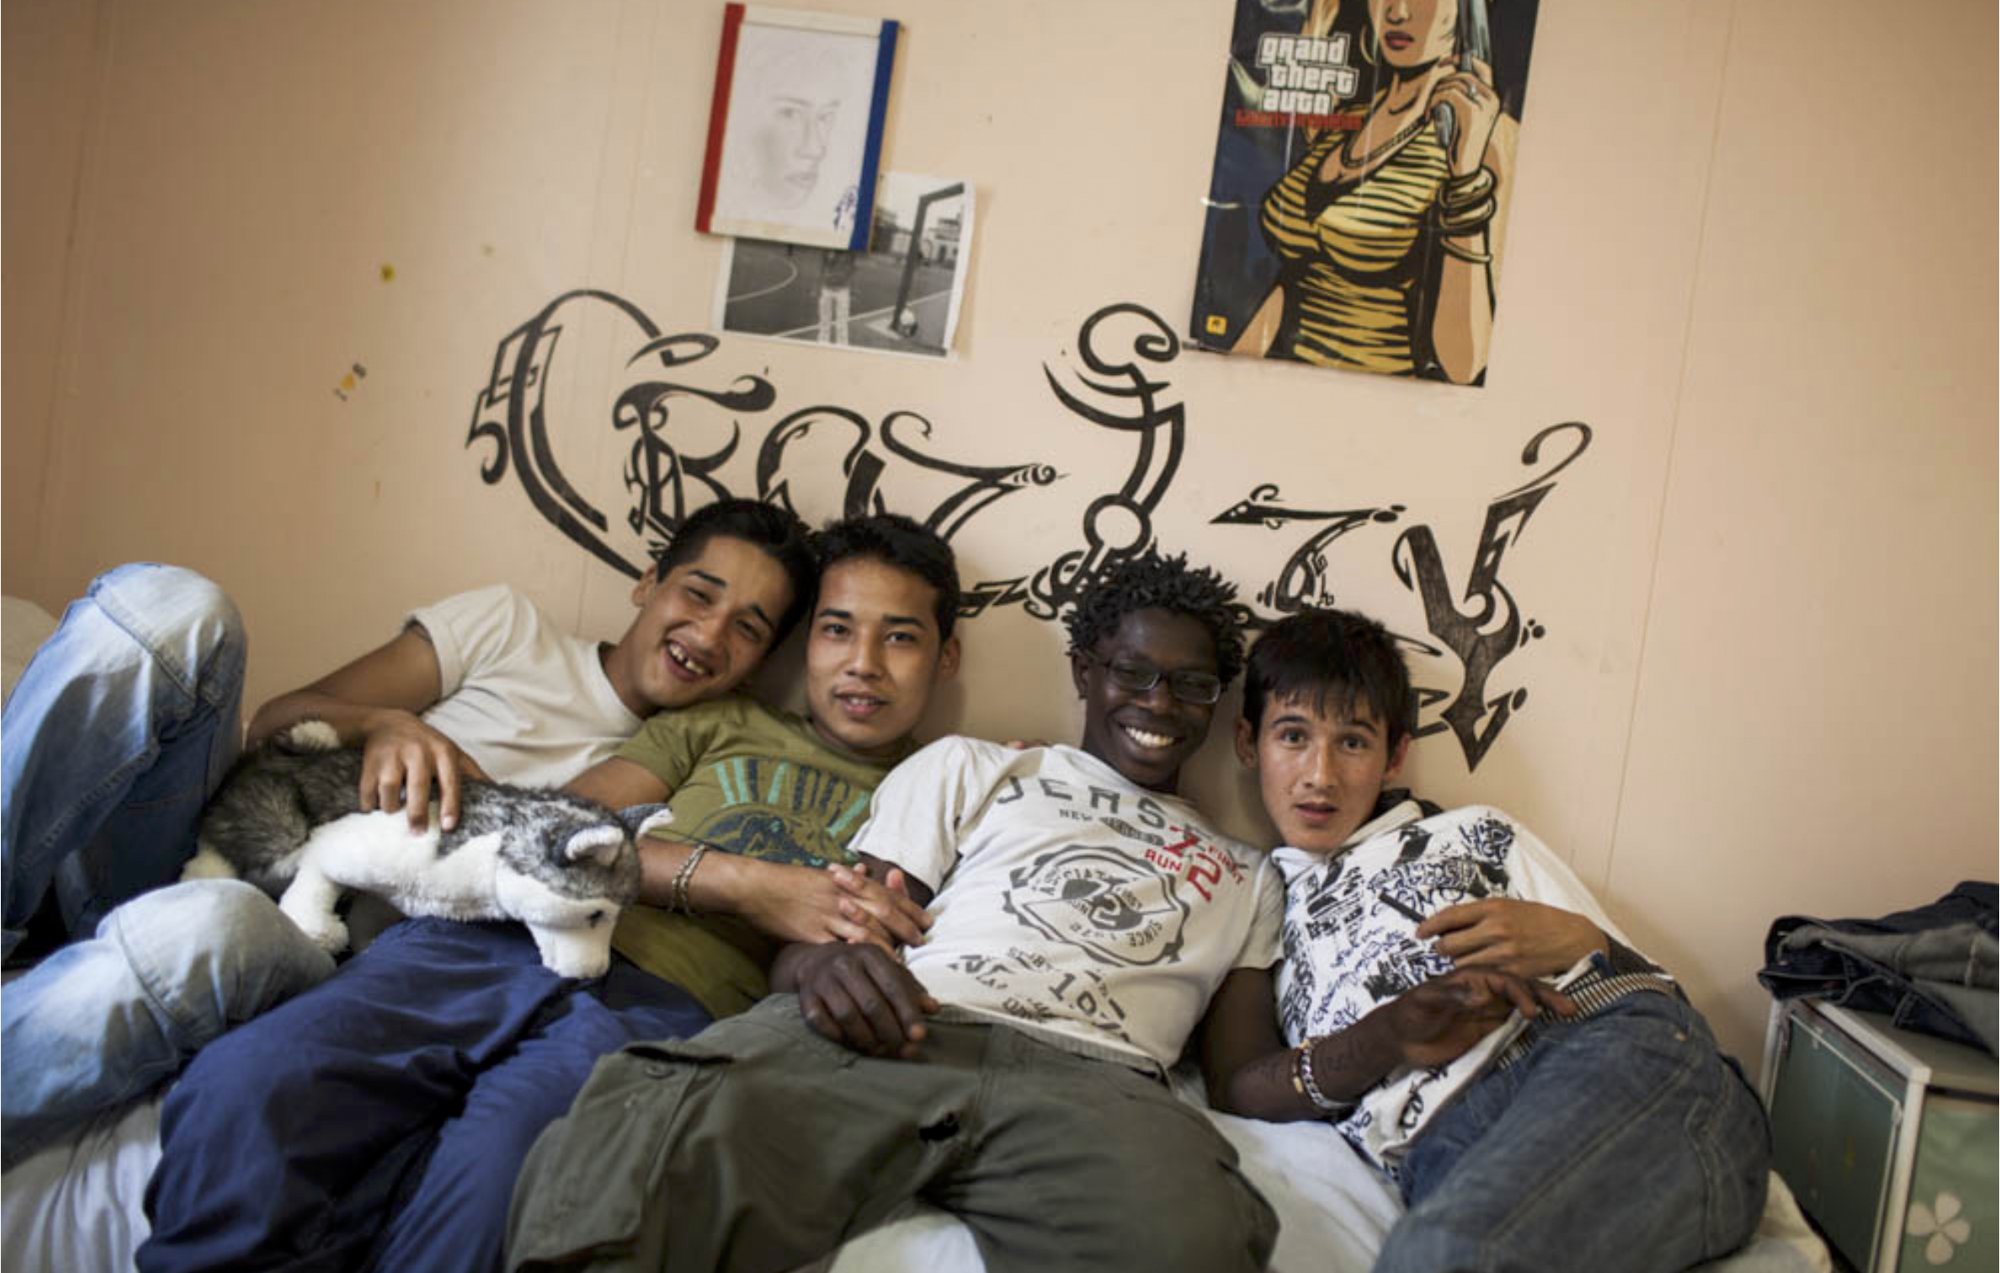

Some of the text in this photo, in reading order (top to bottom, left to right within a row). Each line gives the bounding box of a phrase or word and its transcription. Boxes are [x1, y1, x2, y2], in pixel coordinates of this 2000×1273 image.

[1261, 36, 1346, 65] grand
[1271, 61, 1354, 94] theft
[1263, 88, 1331, 115] auto
[1144, 848, 1183, 872] RUN
